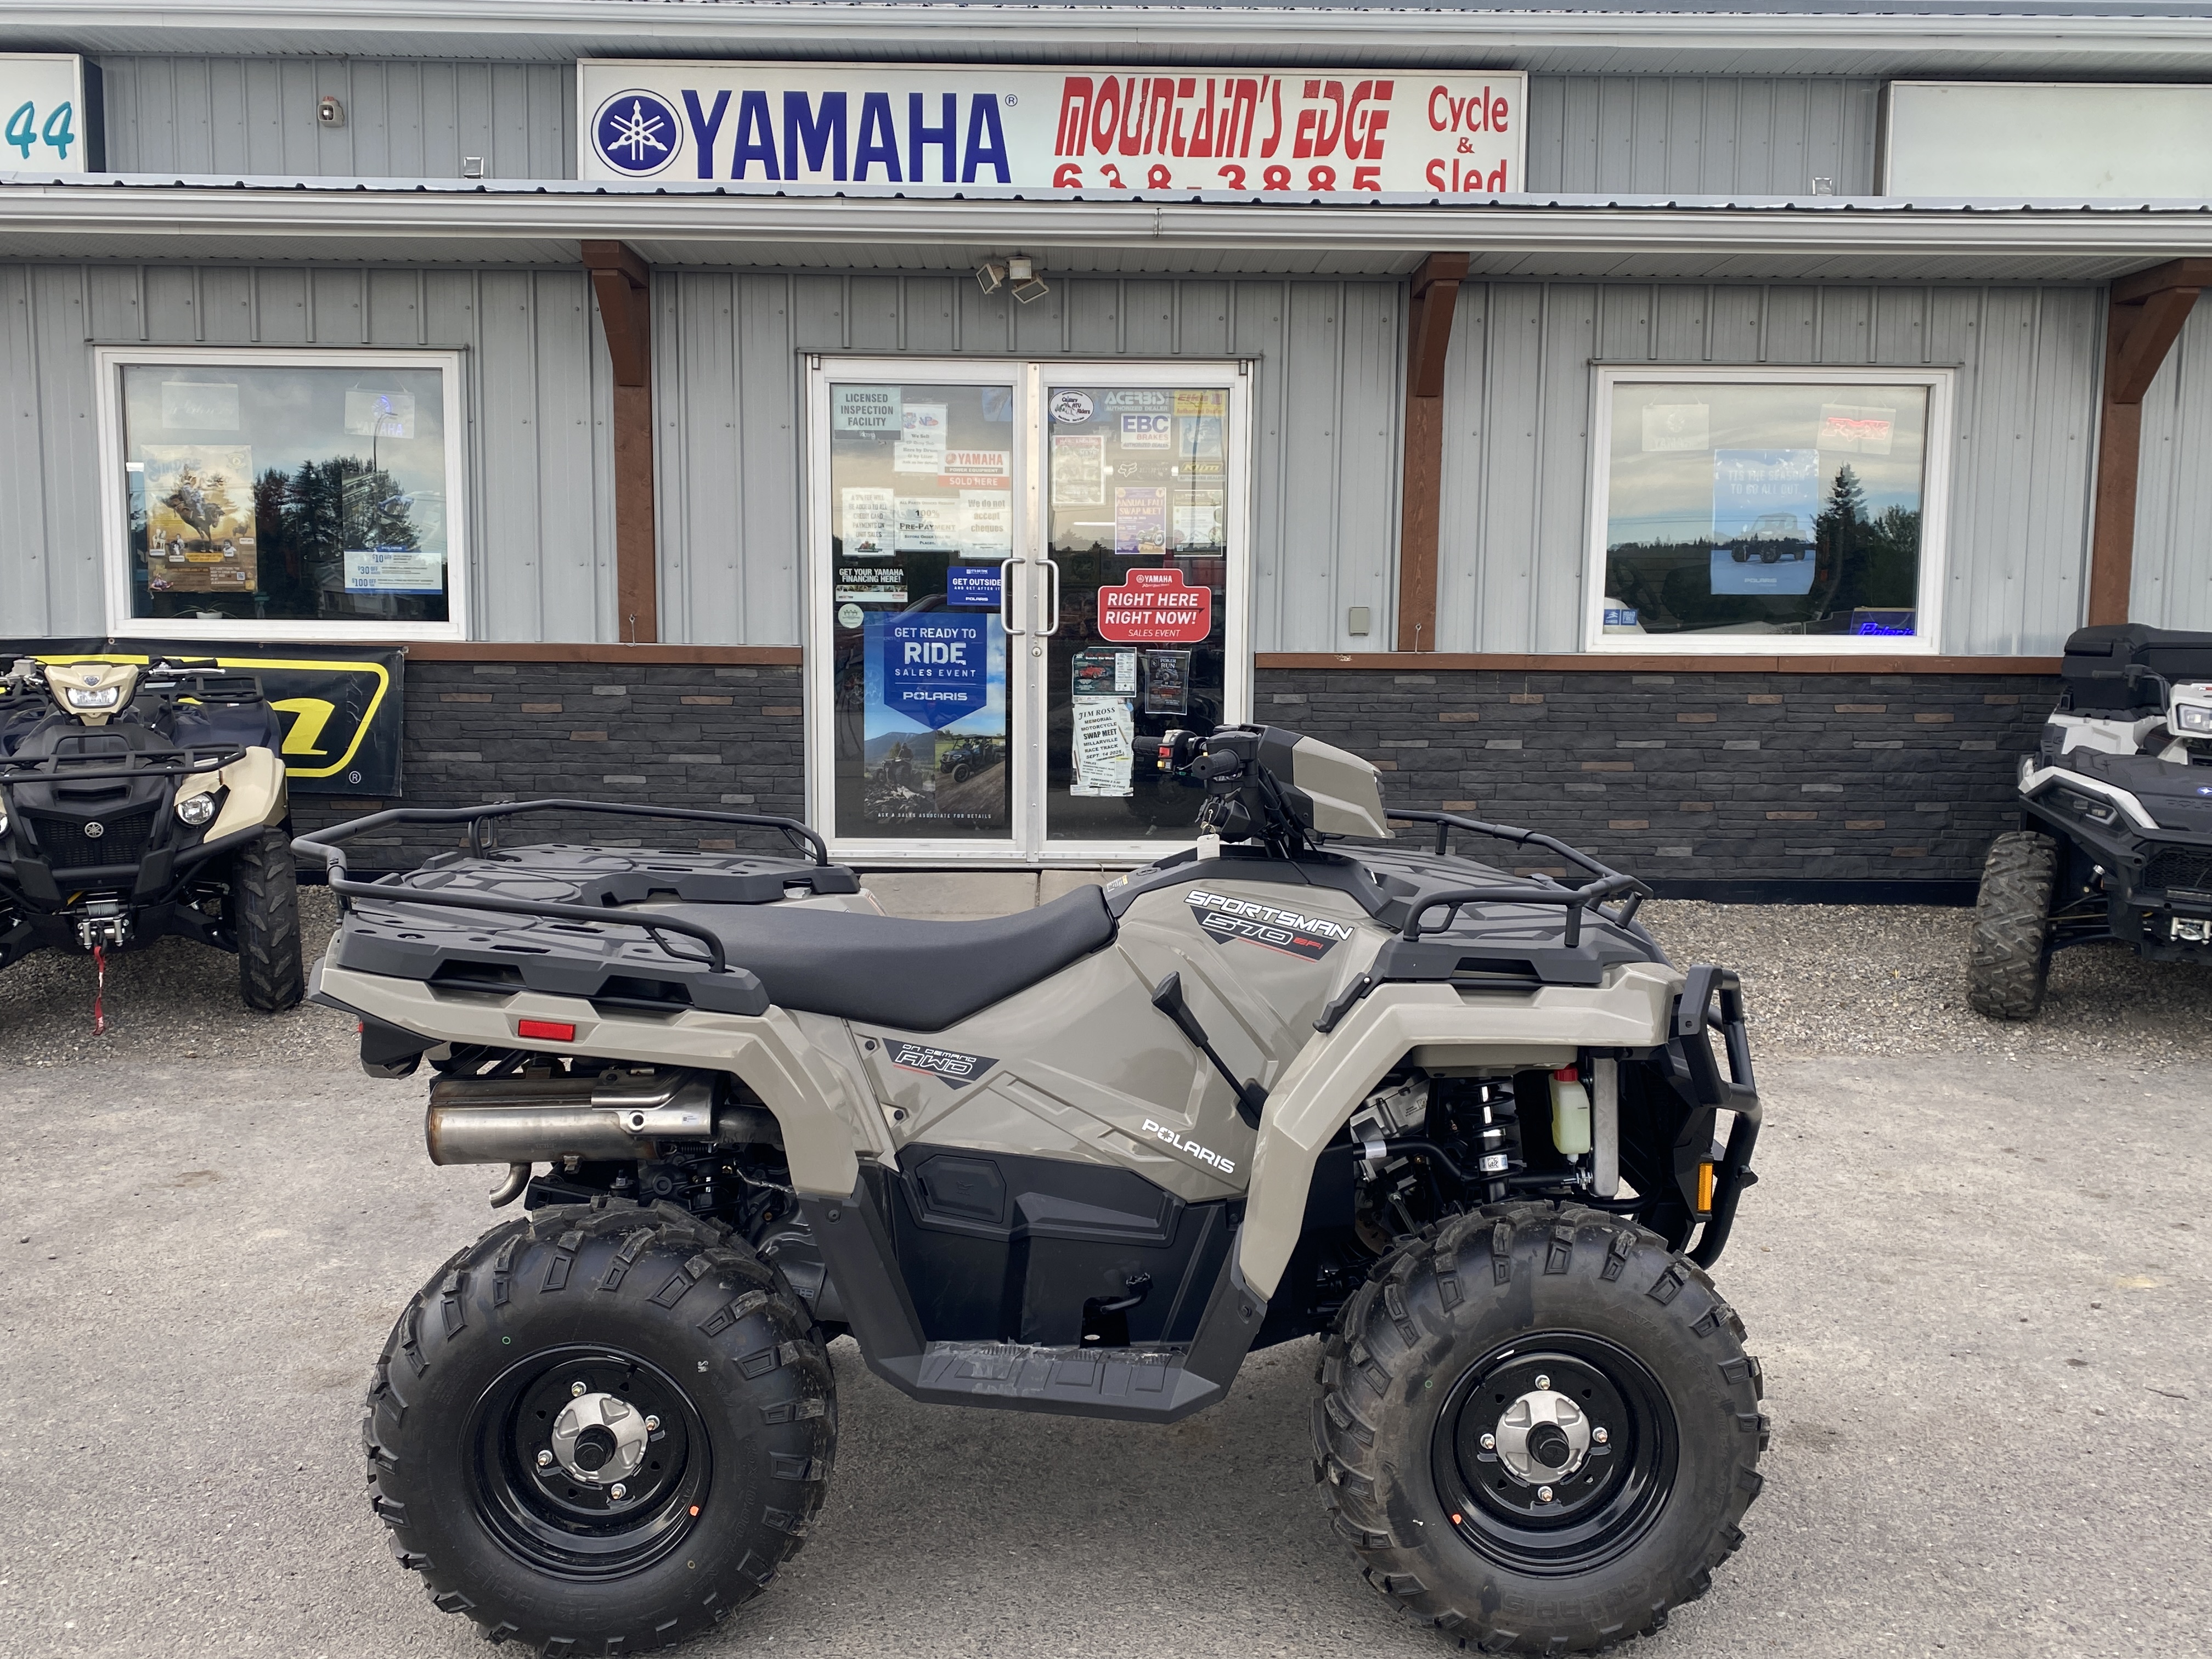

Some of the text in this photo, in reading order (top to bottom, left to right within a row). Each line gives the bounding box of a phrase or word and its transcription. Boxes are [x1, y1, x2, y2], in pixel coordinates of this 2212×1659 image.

[1429, 85, 1509, 133] Cycle
[1292, 80, 1395, 160] EDGE
[5, 101, 74, 160] 44
[681, 90, 1012, 184] YAMAHA
[1457, 137, 1475, 154] &
[1426, 159, 1507, 193] Sled
[845, 393, 888, 403] LICENSED
[1104, 391, 1165, 405] ACERBIS
[840, 405, 894, 415] INSPECTION
[848, 417, 887, 426] FACILITY
[1123, 415, 1169, 433] EBC
[958, 453, 1003, 465] YAMAHA
[1748, 470, 1765, 481] THE
[949, 477, 998, 486] SOLD HERE
[1731, 483, 1742, 494] TO
[968, 499, 980, 507] We
[974, 512, 1000, 521] accept
[971, 524, 1004, 533] cheques
[372, 554, 383, 563] $10
[358, 566, 370, 574] $30
[352, 578, 368, 587] $100
[1144, 575, 1173, 583] YAMAHA
[1107, 593, 1199, 606] RIGHT HERE
[1105, 611, 1197, 625] RIGHT NOW!
[895, 628, 977, 639] GET READY TO
[905, 642, 967, 665] RIDE
[895, 668, 933, 676] SALES
[903, 692, 968, 701] POLARIS
[1078, 707, 1115, 720] JIM ROSS
[1081, 722, 1117, 731] MOTORCYCLE
[1083, 731, 1101, 740] SWAP
[1084, 737, 1118, 747] MILLARVILLE
[1184, 890, 1355, 940] SPORTSMAN
[1201, 912, 1324, 950] 570 EFI
[902, 1043, 977, 1063] ON DEMAND
[894, 1050, 973, 1075] AWD
[1142, 1119, 1235, 1173] POLARIS
